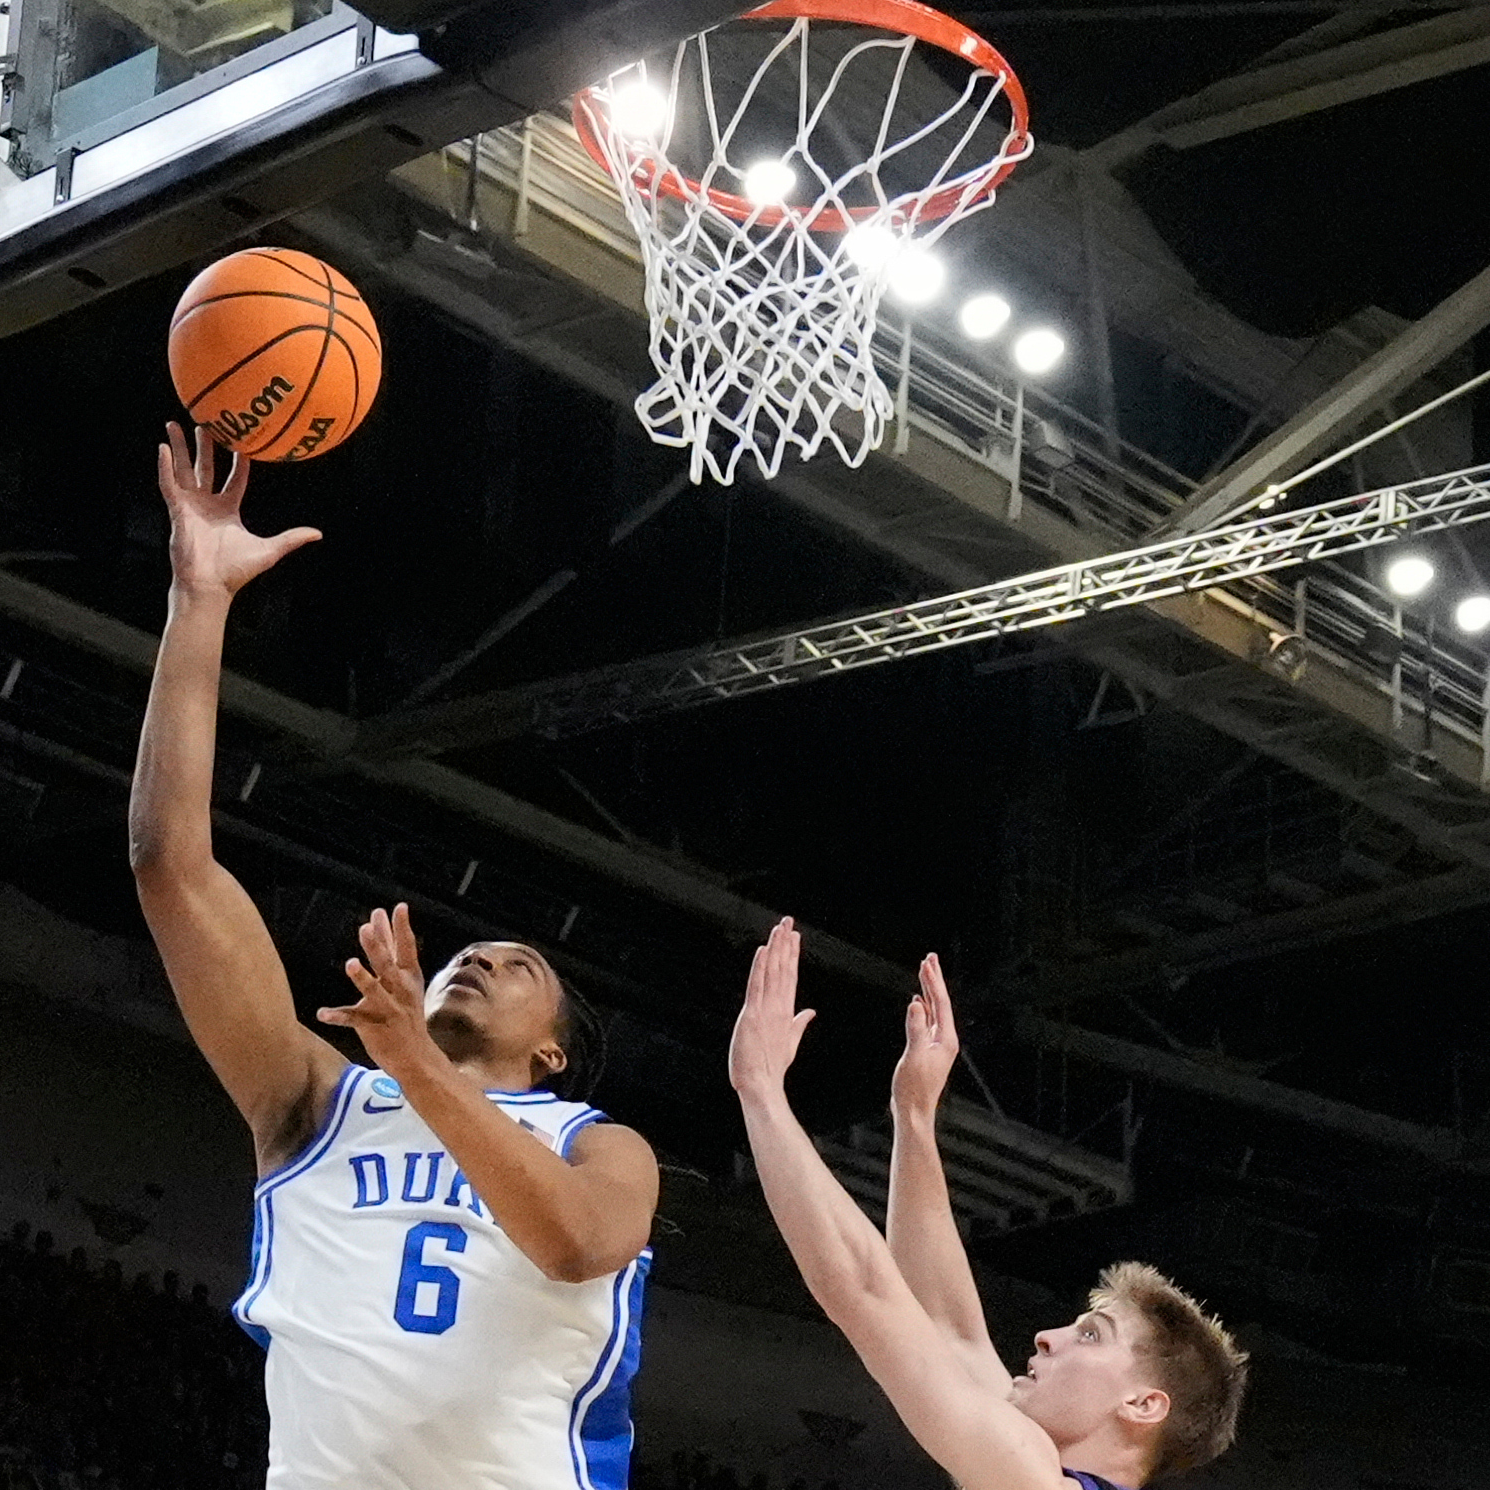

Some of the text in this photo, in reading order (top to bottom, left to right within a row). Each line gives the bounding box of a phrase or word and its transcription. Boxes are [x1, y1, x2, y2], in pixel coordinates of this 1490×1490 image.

[278, 417, 336, 460] CAA
[349, 1151, 496, 1222] DUK
[394, 1221, 468, 1335] 6
